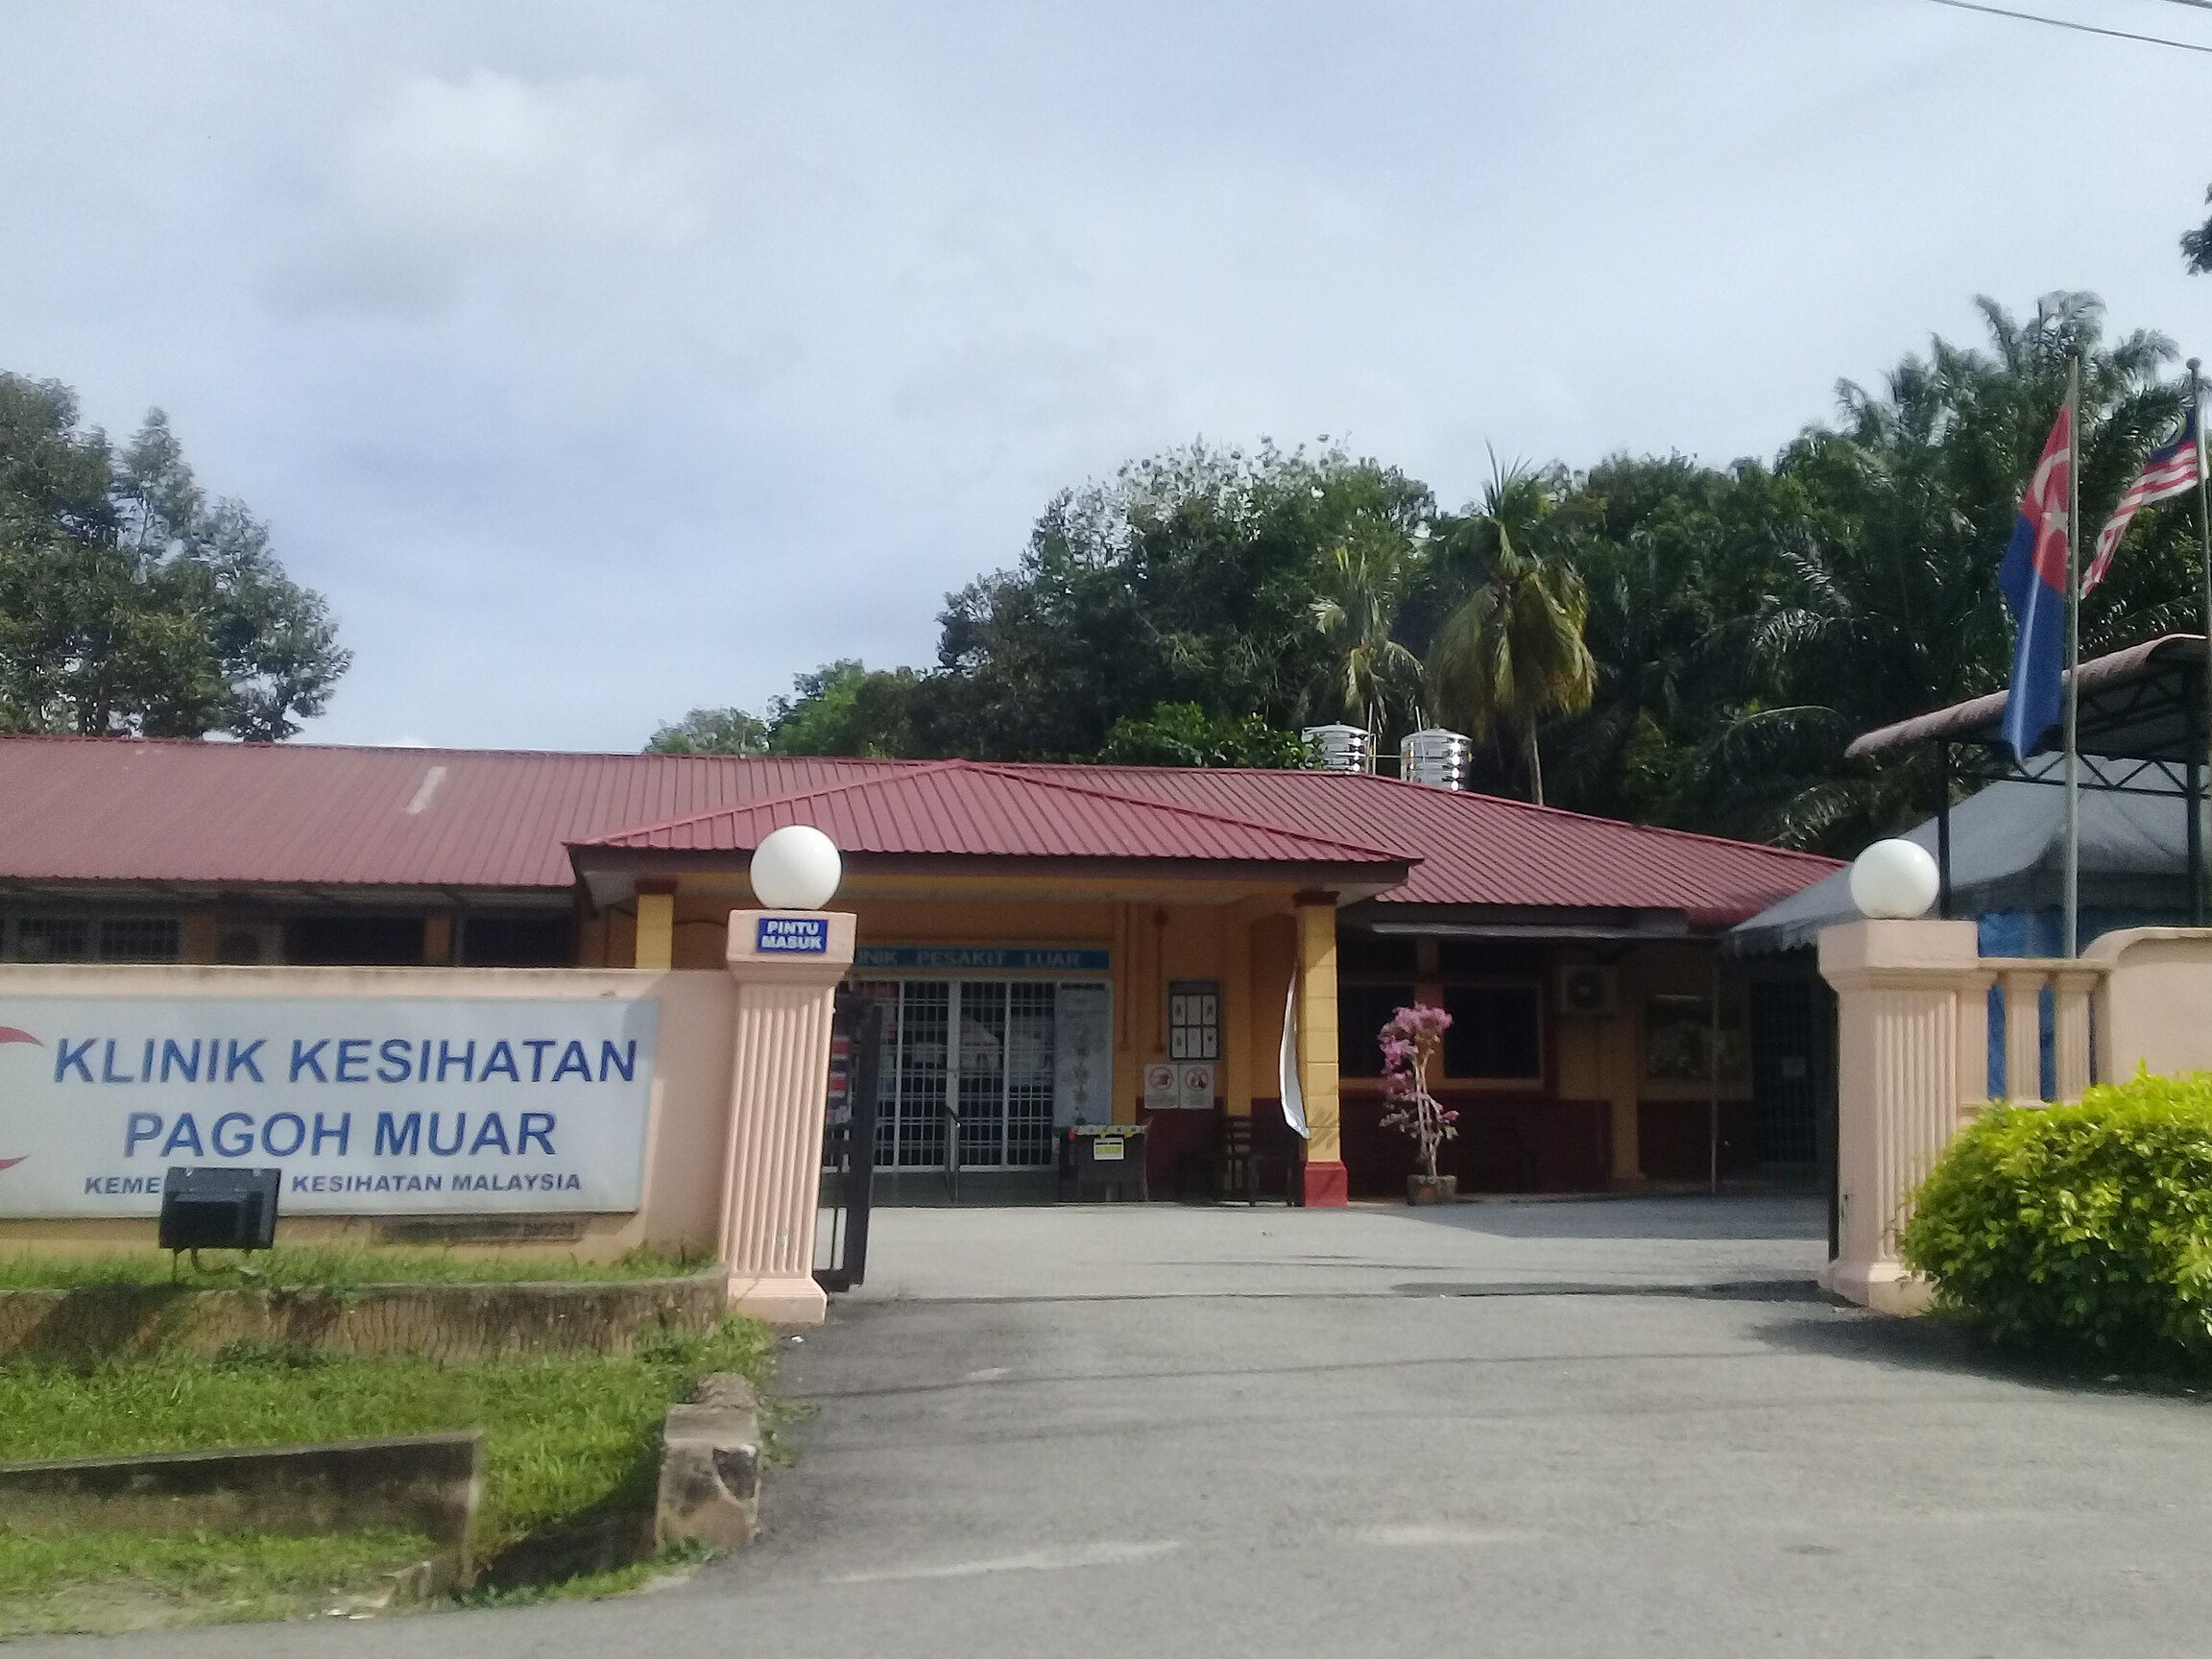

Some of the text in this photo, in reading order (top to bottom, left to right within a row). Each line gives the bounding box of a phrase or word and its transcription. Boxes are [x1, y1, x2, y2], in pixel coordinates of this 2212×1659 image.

[767, 920, 820, 935] PINTU
[760, 934, 823, 950] MASUK
[1024, 950, 1082, 968] LUAR
[54, 1038, 637, 1083] KLINIK KESIHATAN
[123, 1111, 557, 1158] PAGOH MUAR
[290, 1172, 583, 1193] KESIHATAN MALAYSIA
